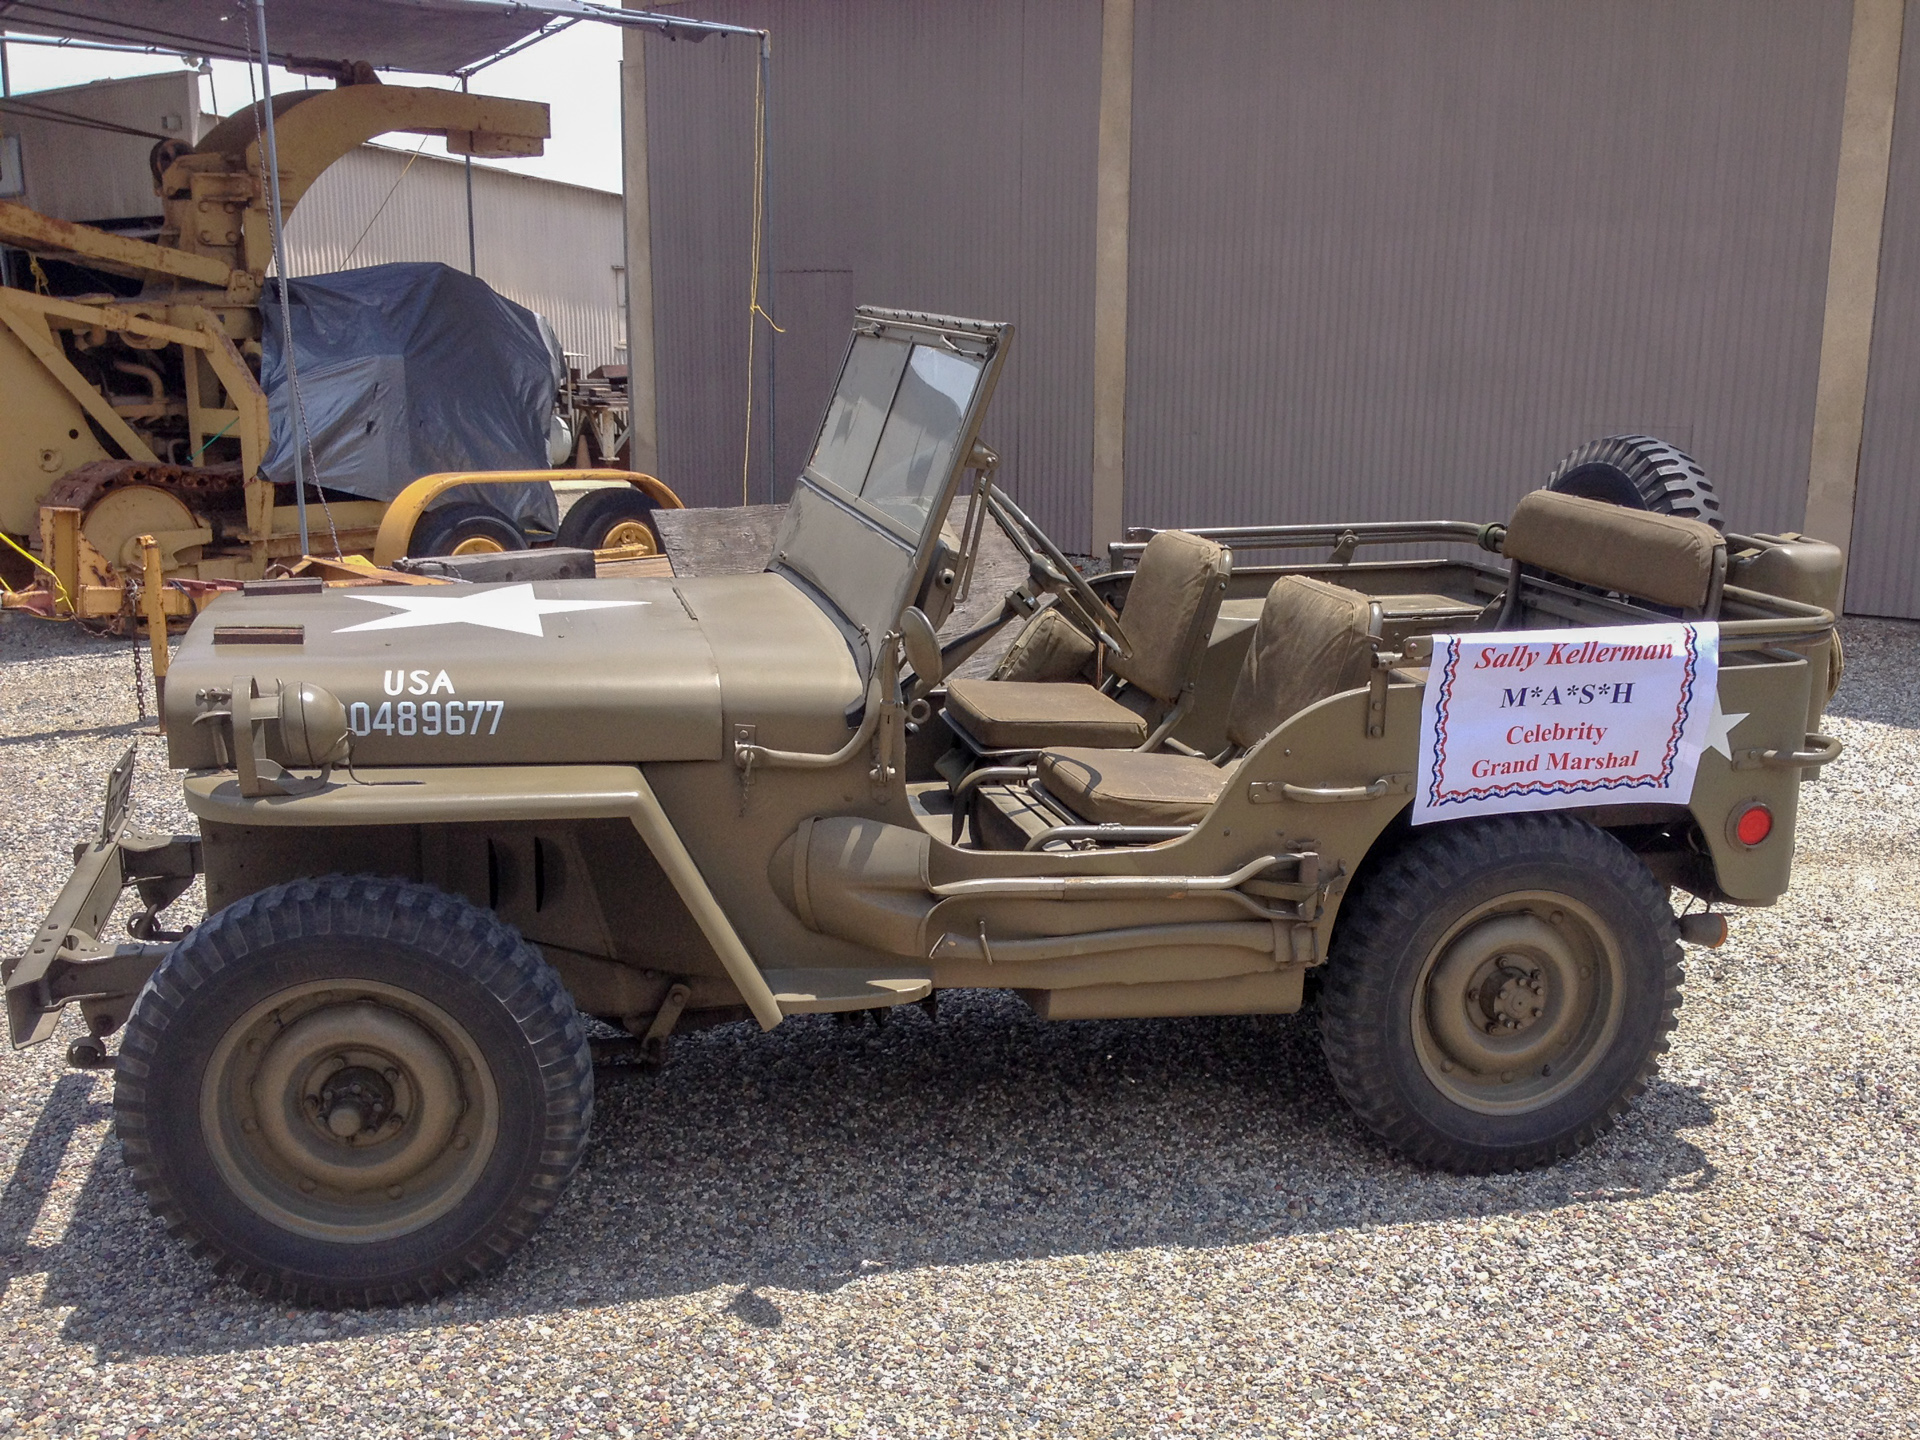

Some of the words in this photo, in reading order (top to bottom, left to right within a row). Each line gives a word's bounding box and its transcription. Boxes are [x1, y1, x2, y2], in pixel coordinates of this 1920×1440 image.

[1475, 646, 1540, 672] Sally
[1545, 640, 1674, 665] Kellerman
[383, 669, 455, 696] USA
[342, 700, 505, 737] 0489677
[1506, 723, 1607, 745] Celebrity
[1471, 753, 1539, 778] Grand
[1546, 750, 1639, 771] Marshal
